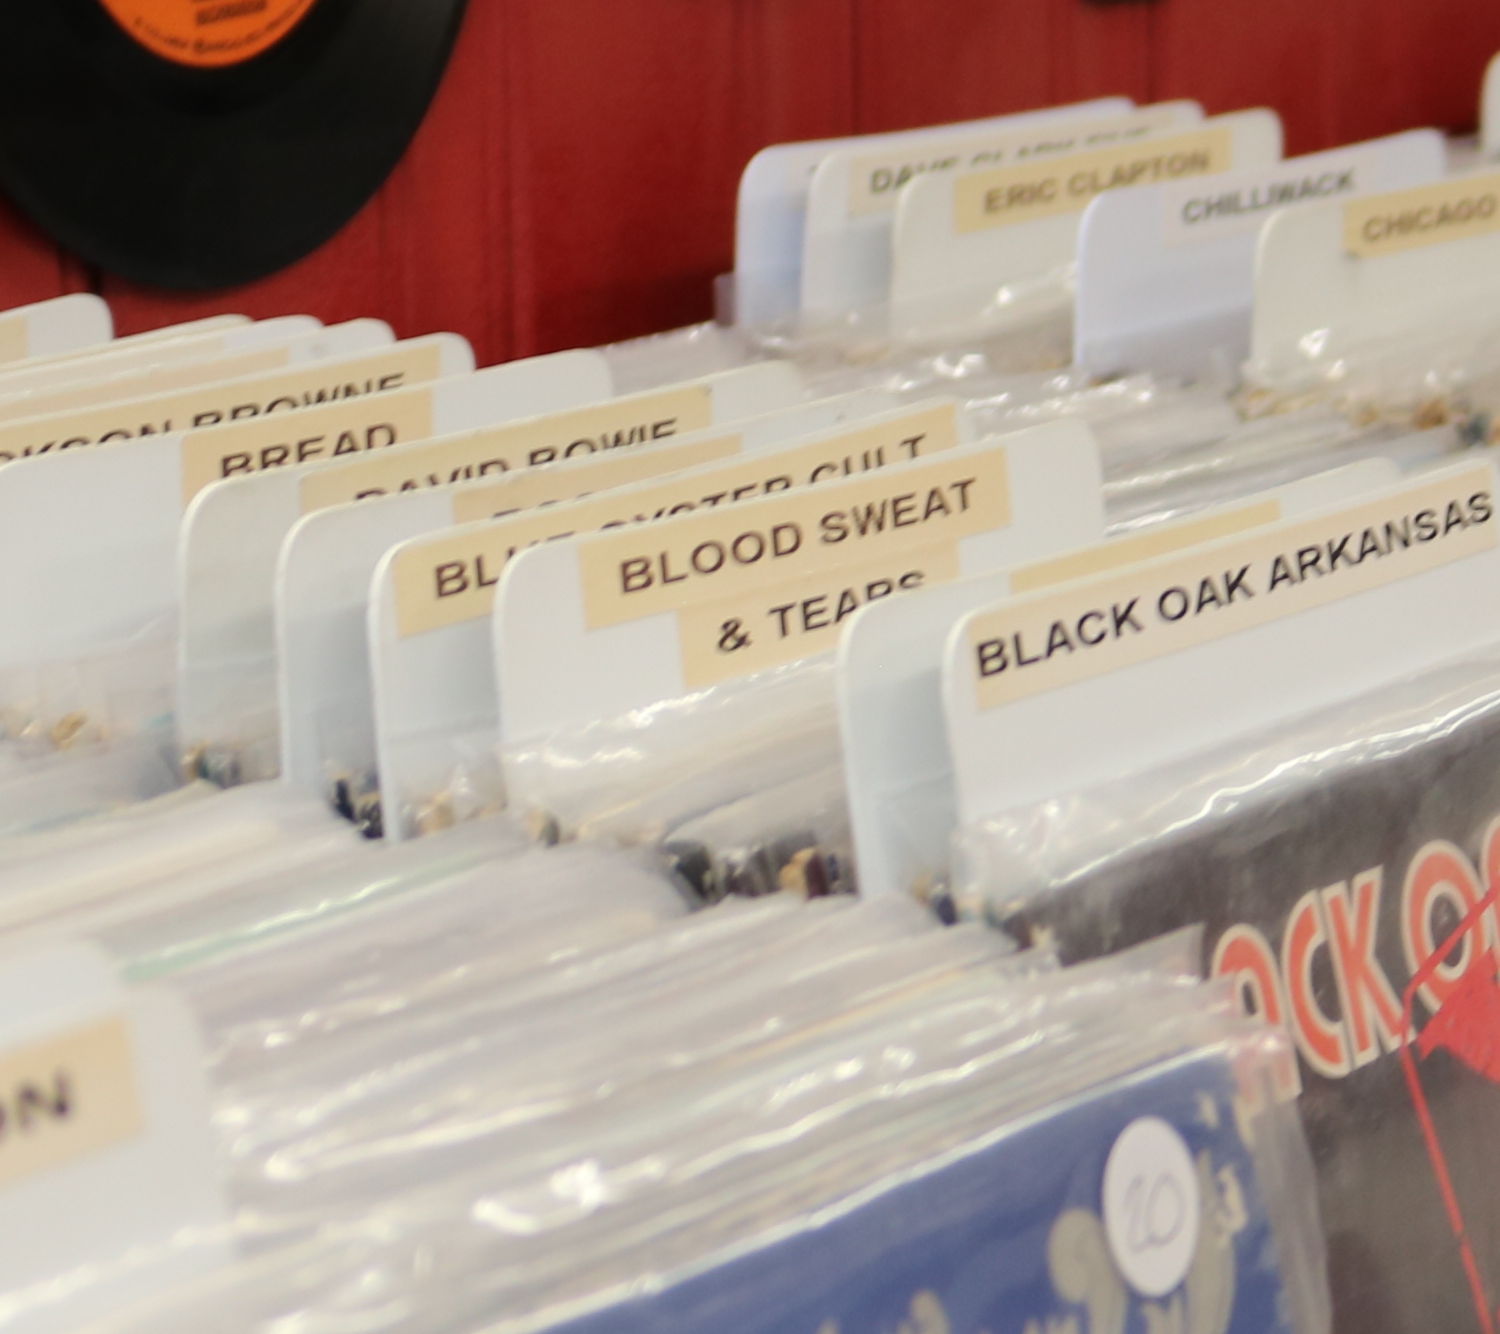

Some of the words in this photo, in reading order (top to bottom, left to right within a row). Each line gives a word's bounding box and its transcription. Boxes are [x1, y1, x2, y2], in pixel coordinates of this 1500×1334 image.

[982, 170, 1059, 215] ERIC
[1067, 146, 1213, 199] CLAPTON
[1180, 167, 1356, 227] CHILLIWACK
[1361, 192, 1499, 245] CHICAGO
[617, 521, 803, 596] BLOOD
[817, 477, 979, 549] SWEAT
[971, 593, 1144, 681] BLACK
[1155, 559, 1254, 624] OAK
[1265, 489, 1494, 595] ARKANSAS
[716, 617, 752, 654] &
